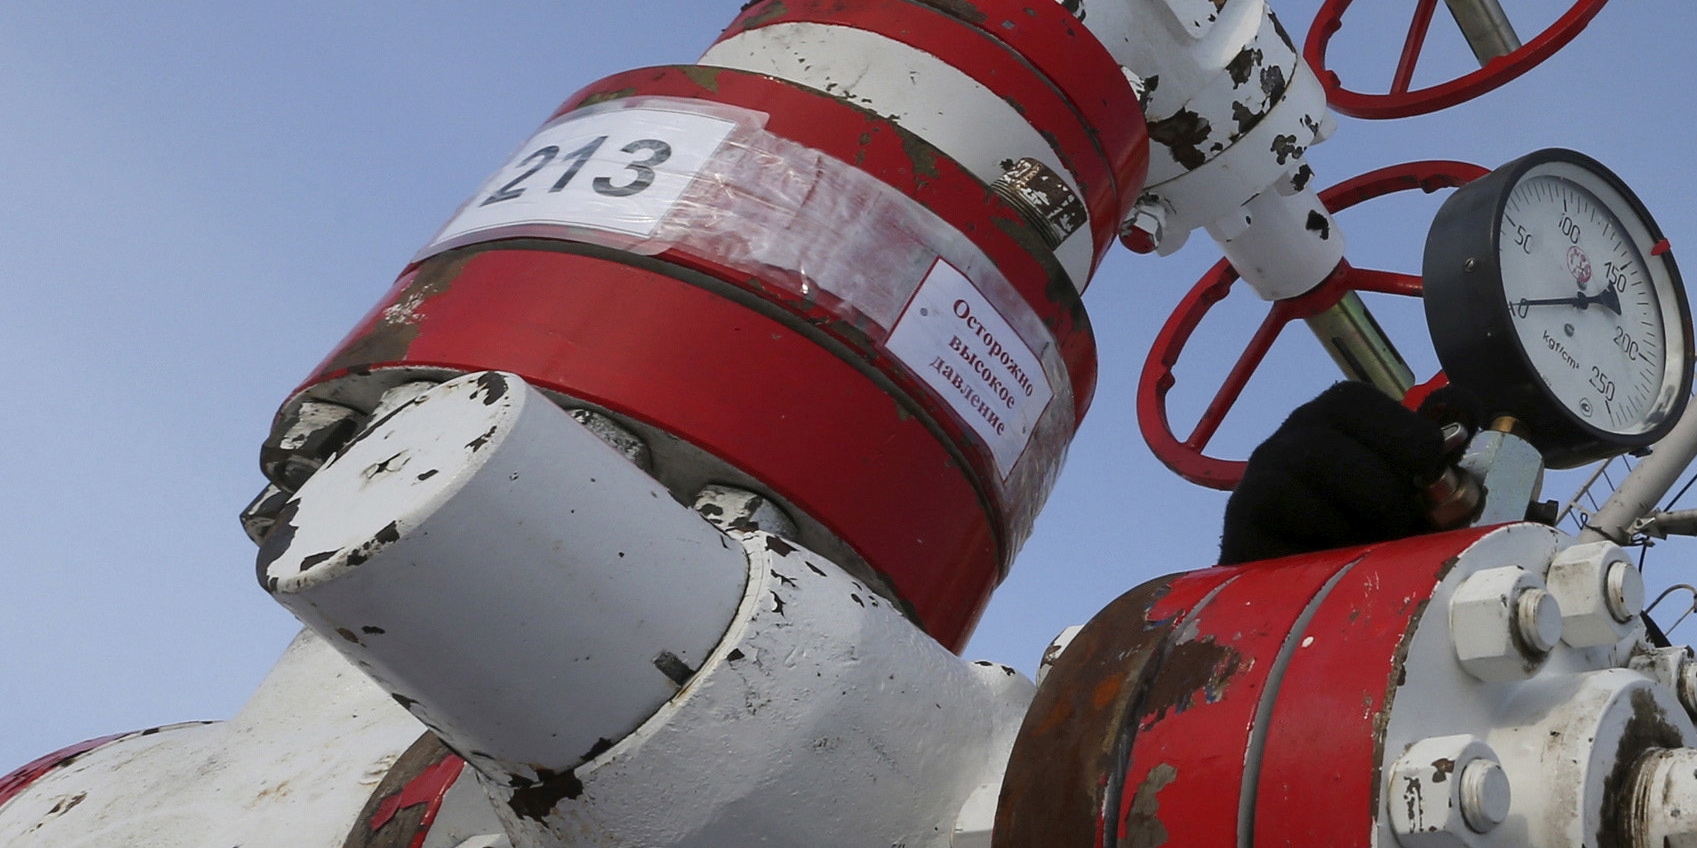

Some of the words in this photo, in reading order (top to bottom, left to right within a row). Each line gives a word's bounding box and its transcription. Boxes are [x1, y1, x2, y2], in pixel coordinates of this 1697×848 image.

[478, 135, 672, 208] 213
[1514, 225, 1533, 254] 50
[1558, 212, 1581, 244] 100
[1604, 261, 1627, 293] 150
[953, 299, 1034, 397] Осторожно
[1613, 325, 1639, 361] 200
[948, 334, 1016, 410] высокое
[1589, 365, 1616, 401] 250
[928, 356, 1006, 436] давление
